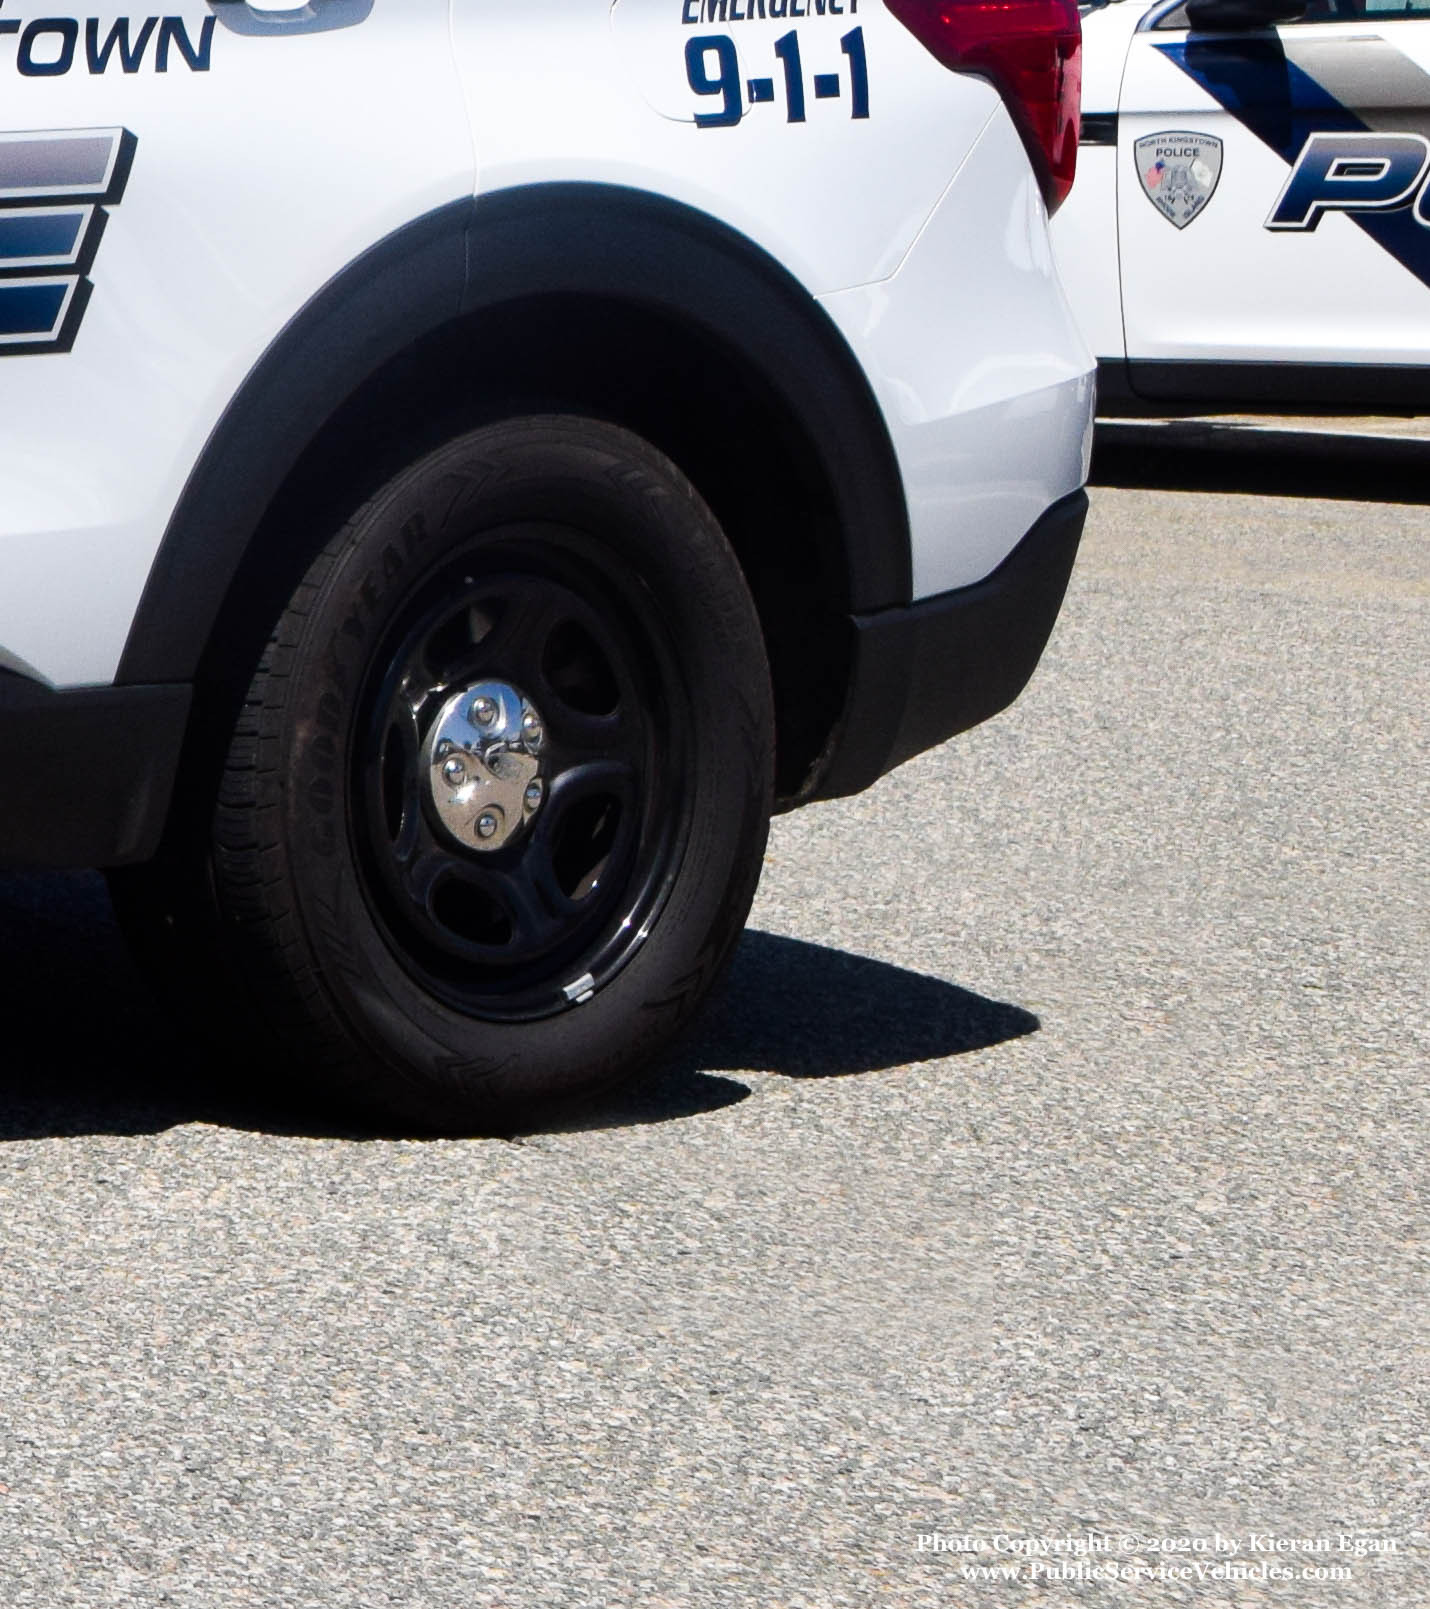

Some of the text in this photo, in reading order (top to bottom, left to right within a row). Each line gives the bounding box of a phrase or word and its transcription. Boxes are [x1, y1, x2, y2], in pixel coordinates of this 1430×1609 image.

[684, 26, 870, 129] 9-1-1
[1156, 147, 1200, 158] POLICE
[1263, 131, 1430, 234] P
